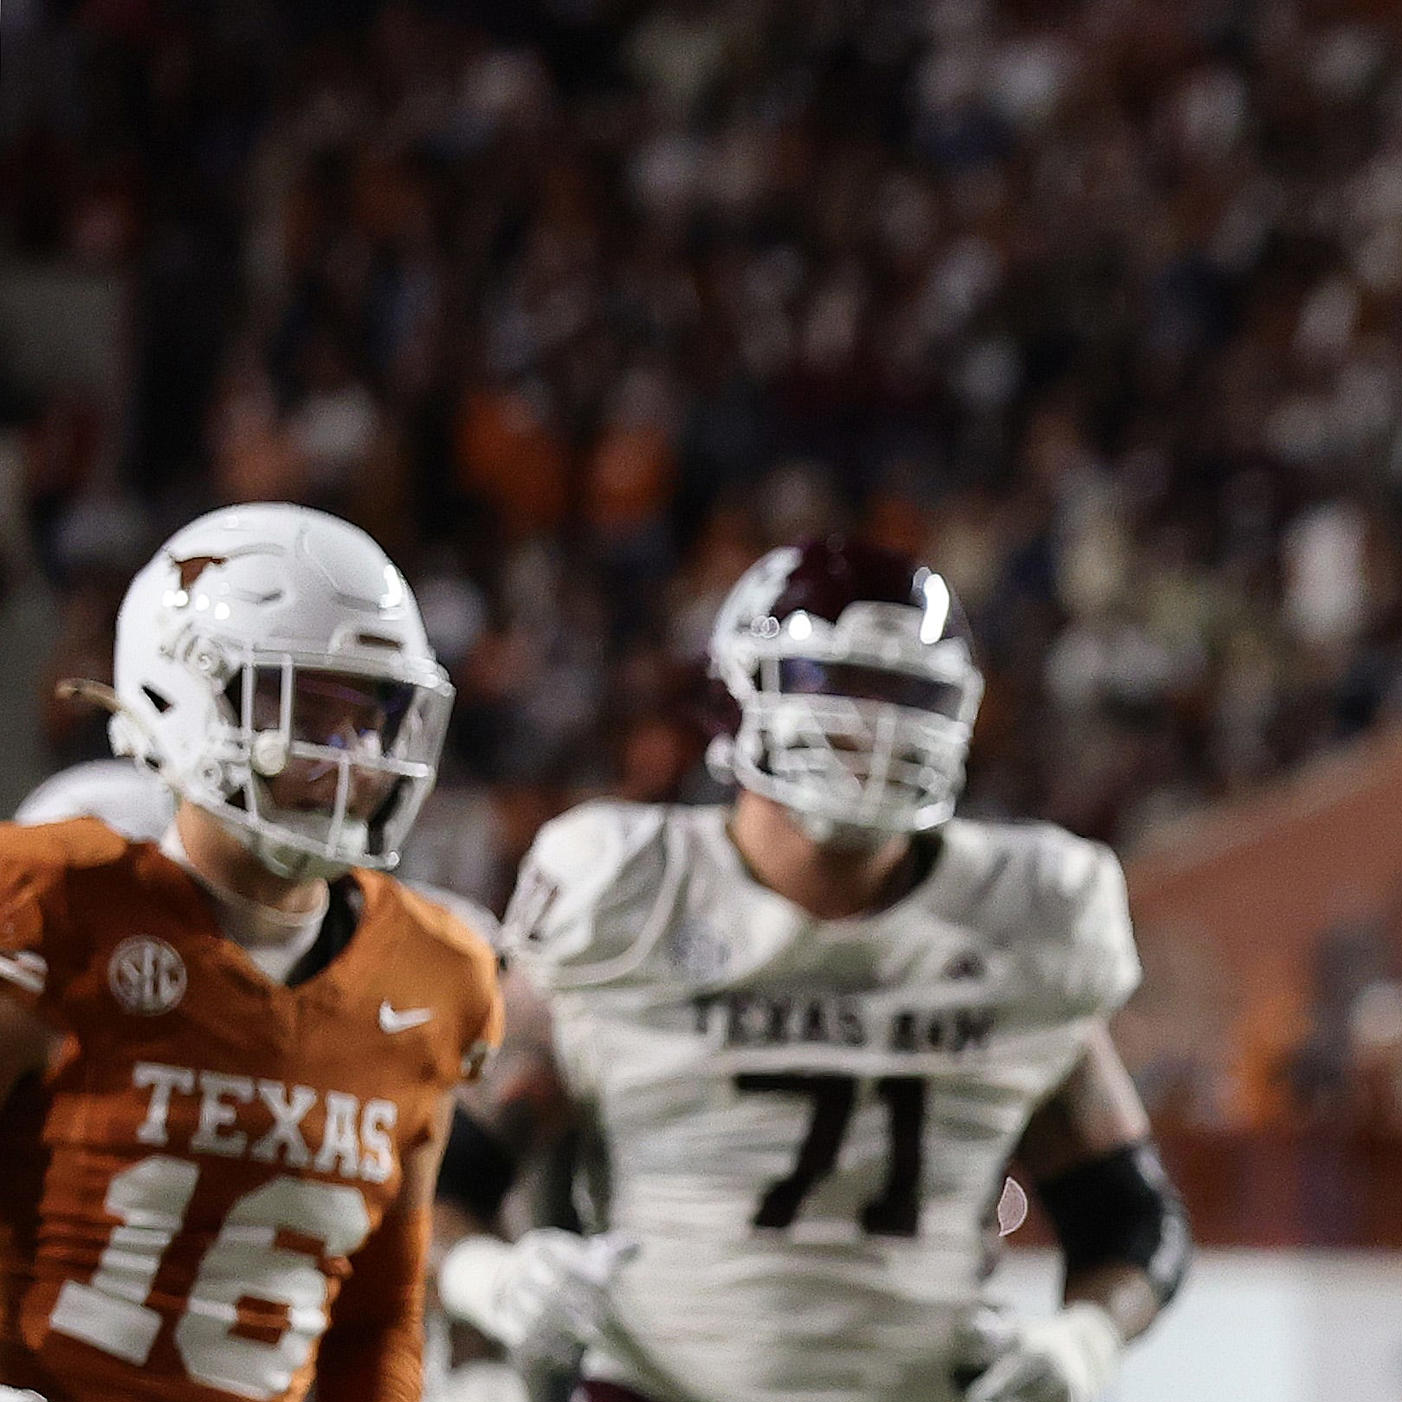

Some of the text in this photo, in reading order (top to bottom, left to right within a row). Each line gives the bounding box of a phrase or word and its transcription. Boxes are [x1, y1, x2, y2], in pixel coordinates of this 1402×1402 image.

[132, 1060, 398, 1184] TEXAS
[731, 1071, 929, 1237] 71
[49, 1153, 371, 1401] 16
